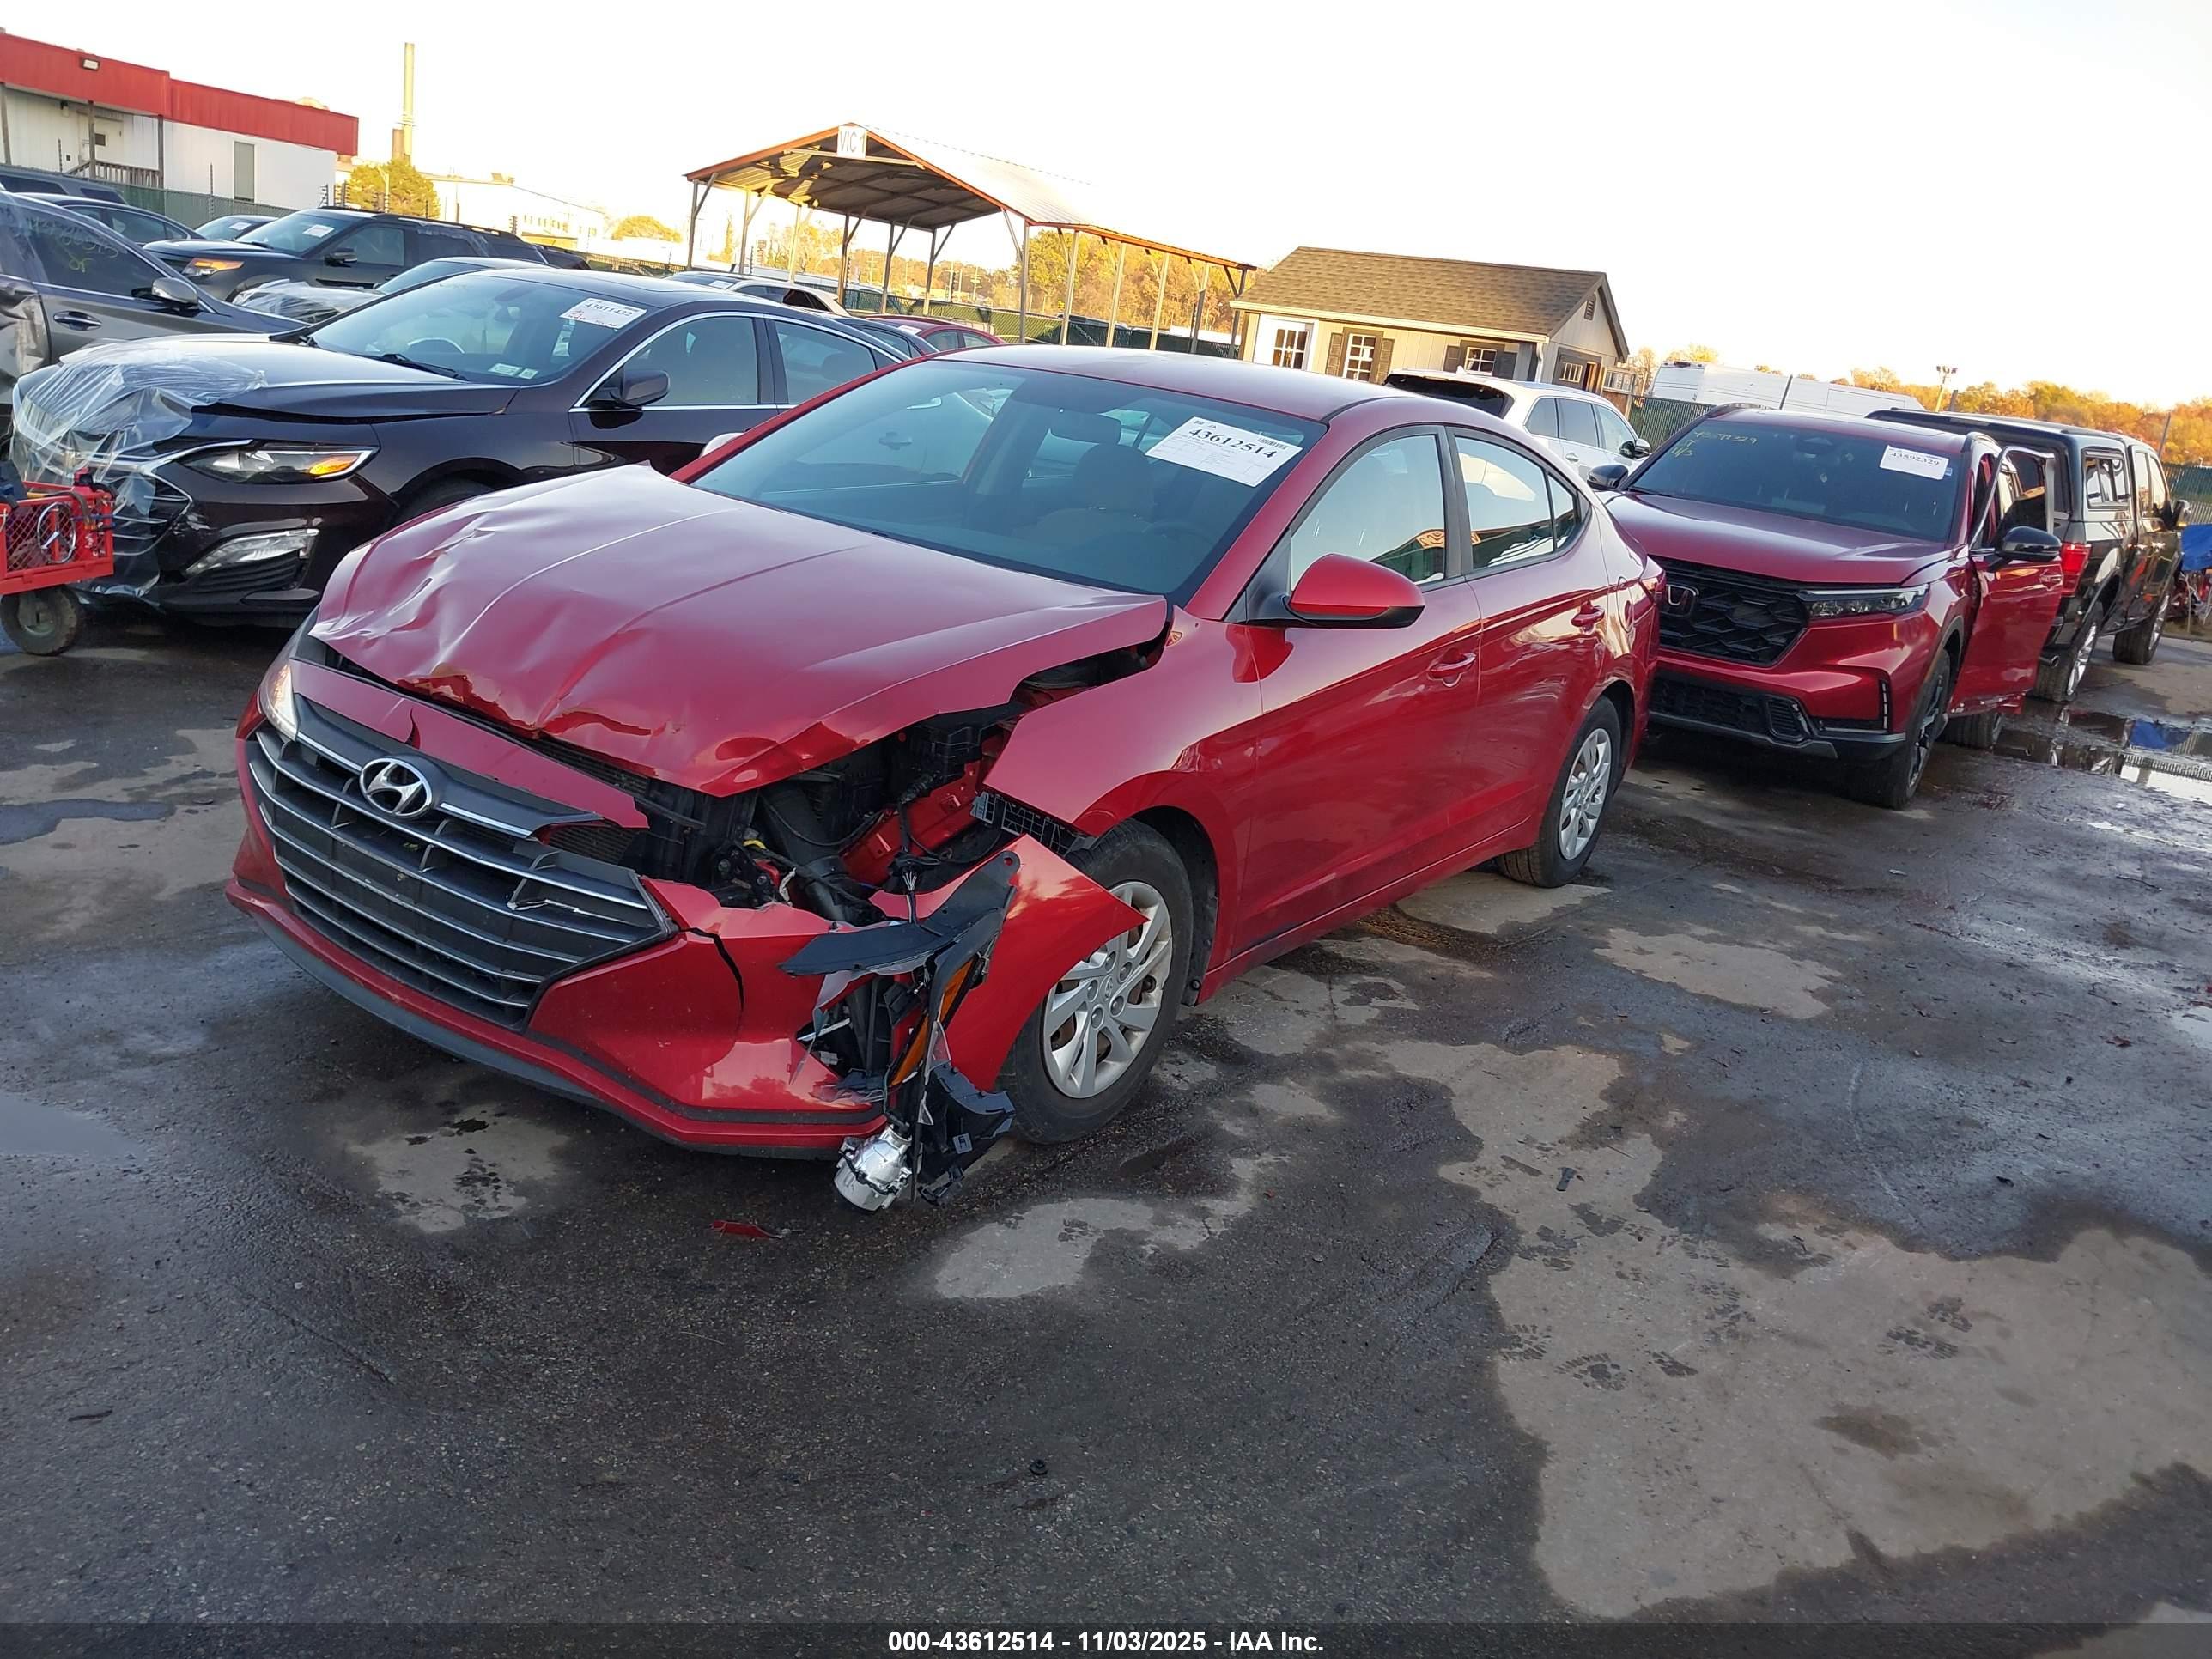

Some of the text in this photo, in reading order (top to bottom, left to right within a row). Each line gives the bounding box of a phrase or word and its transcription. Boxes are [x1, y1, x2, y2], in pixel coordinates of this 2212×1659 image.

[840, 130, 866, 154] VIC 1
[1188, 428, 1278, 459] 43612514
